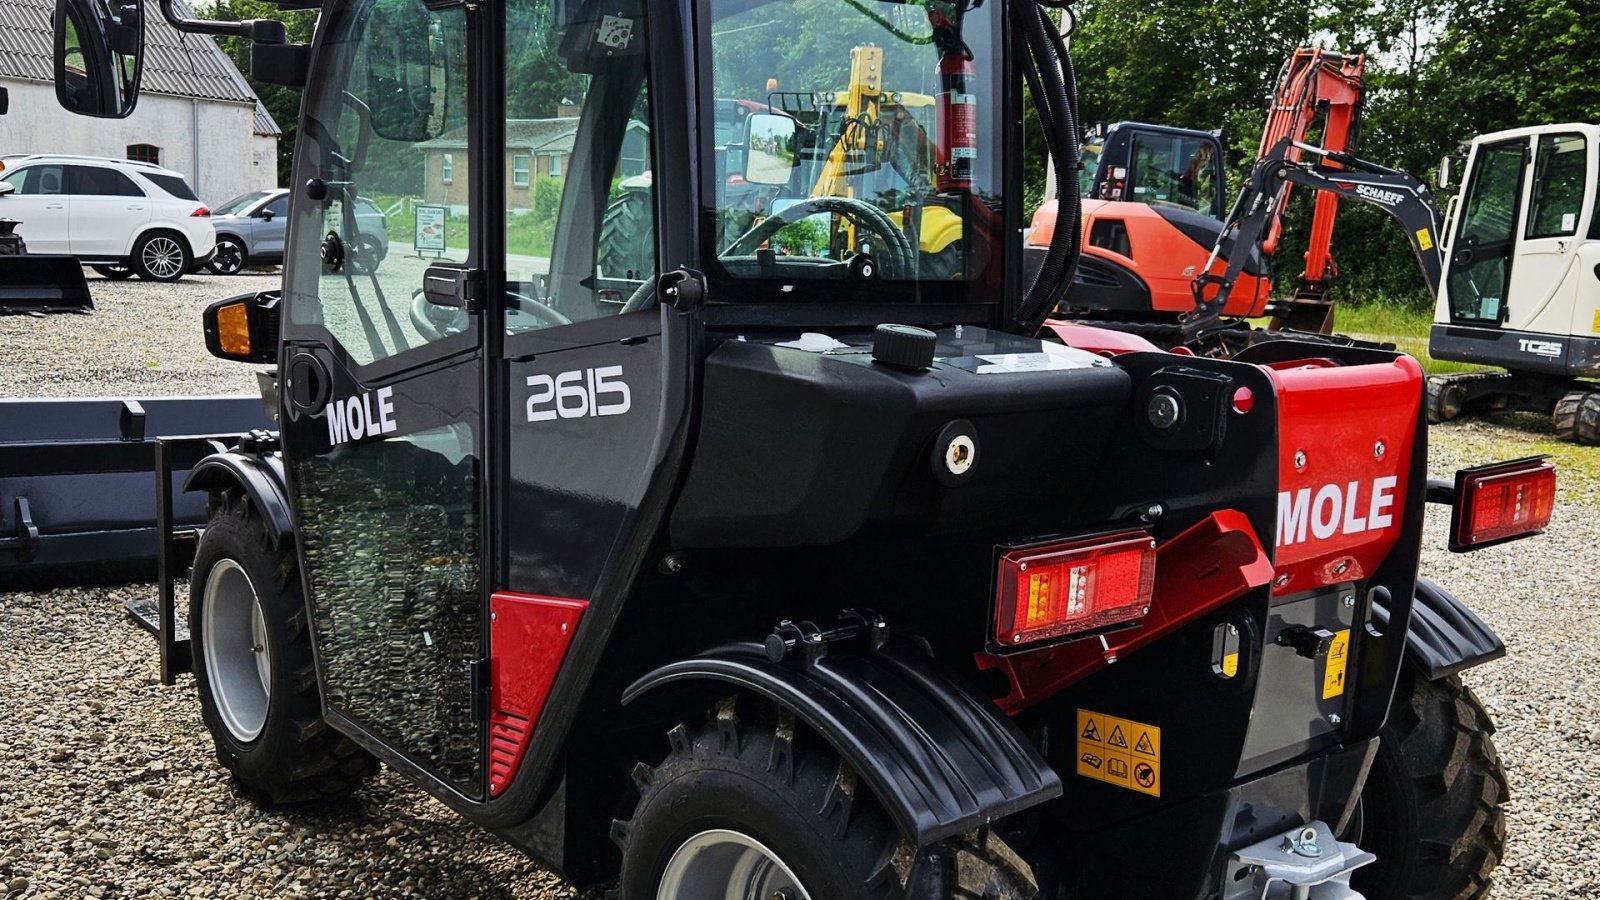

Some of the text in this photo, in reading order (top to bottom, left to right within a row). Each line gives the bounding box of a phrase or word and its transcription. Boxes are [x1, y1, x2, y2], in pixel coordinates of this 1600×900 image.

[1356, 184, 1405, 204] SCHAEFF
[1519, 339, 1562, 356] TC25
[326, 386, 397, 446] MOLE
[526, 365, 631, 422] 2615
[1276, 475, 1397, 547] MOLE
